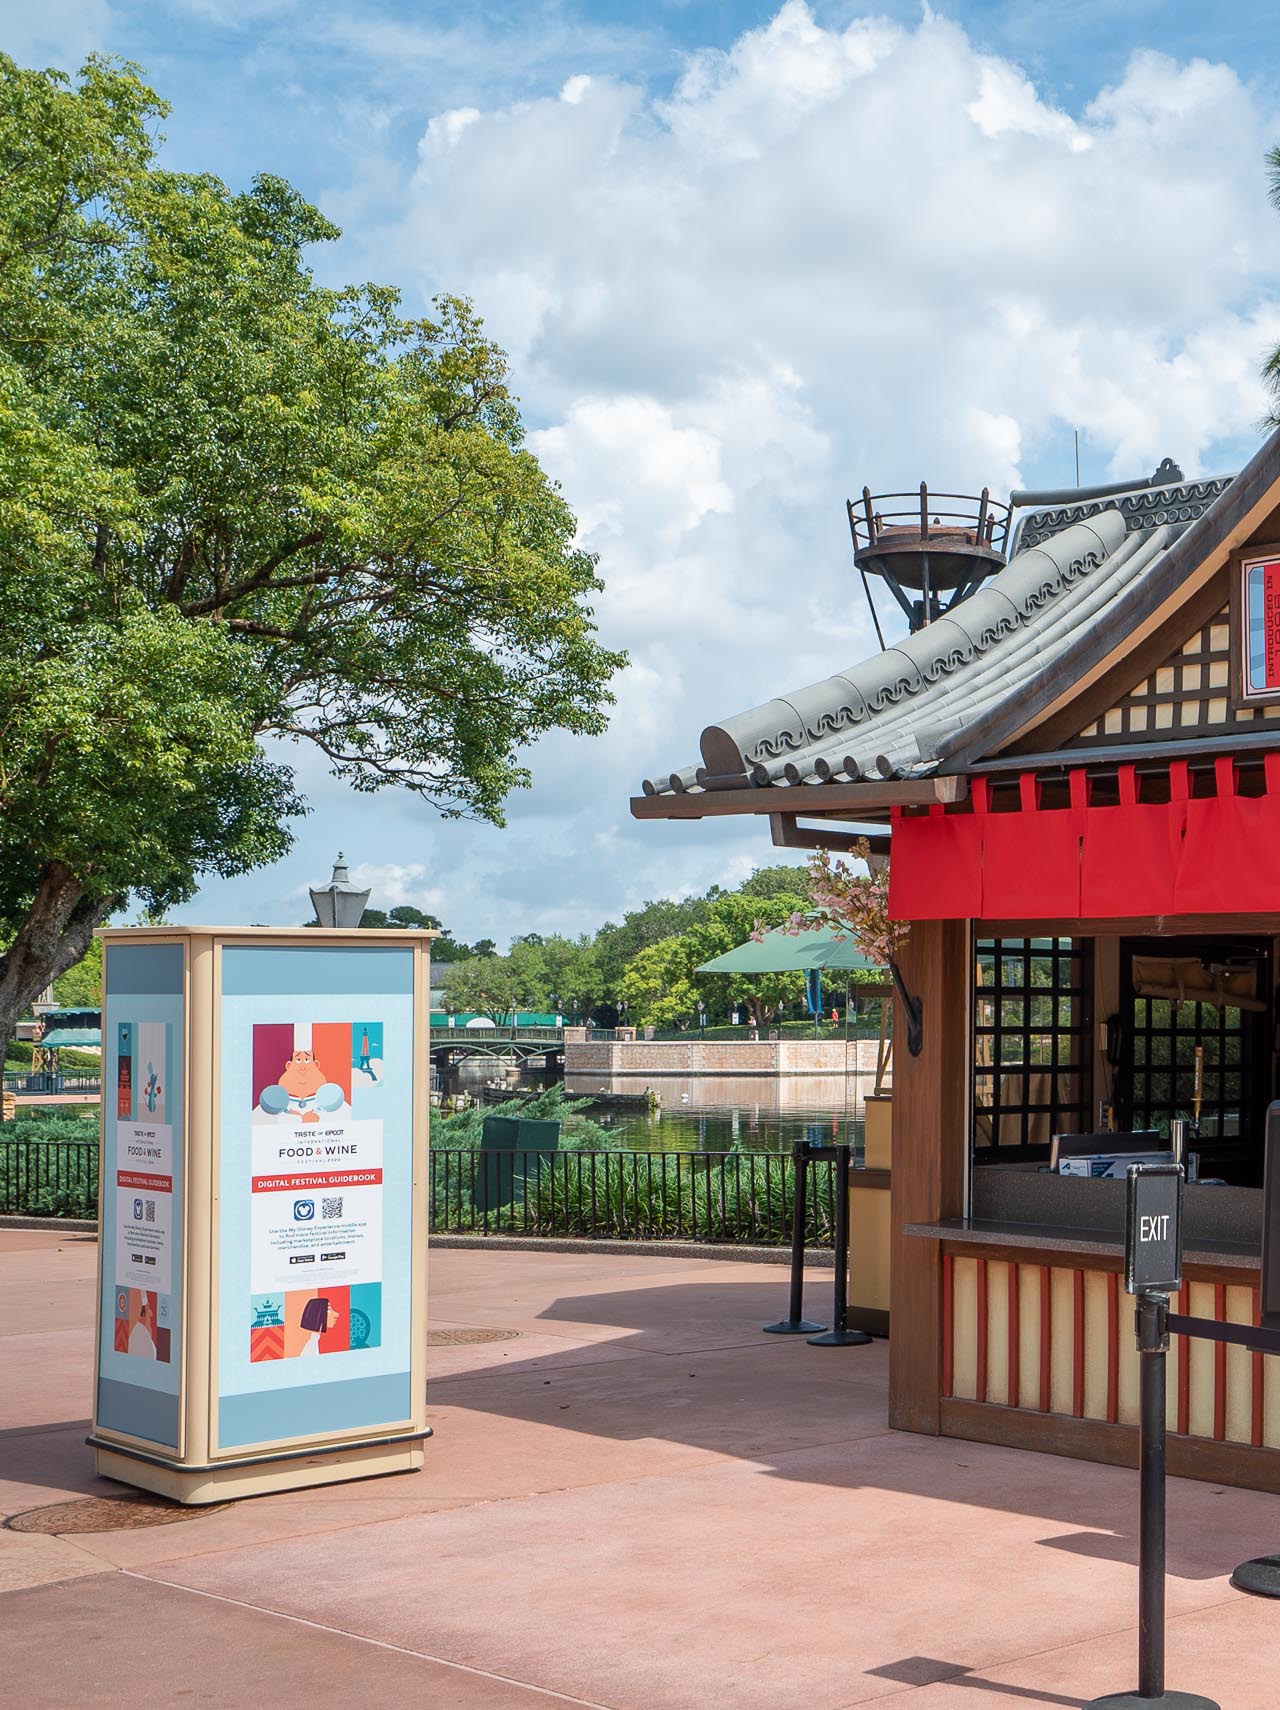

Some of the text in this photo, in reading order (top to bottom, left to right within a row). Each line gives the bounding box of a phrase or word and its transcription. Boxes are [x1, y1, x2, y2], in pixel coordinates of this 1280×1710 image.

[1266, 576, 1275, 677] INTRODUCED IN
[128, 1146, 142, 1156] FOOD
[147, 1149, 161, 1158] WINE
[279, 1145, 358, 1158] FOOD & WINE
[291, 1177, 327, 1186] FESTIVAL
[328, 1174, 376, 1184] GUIDEBOOK
[1140, 1215, 1170, 1242] EXIT
